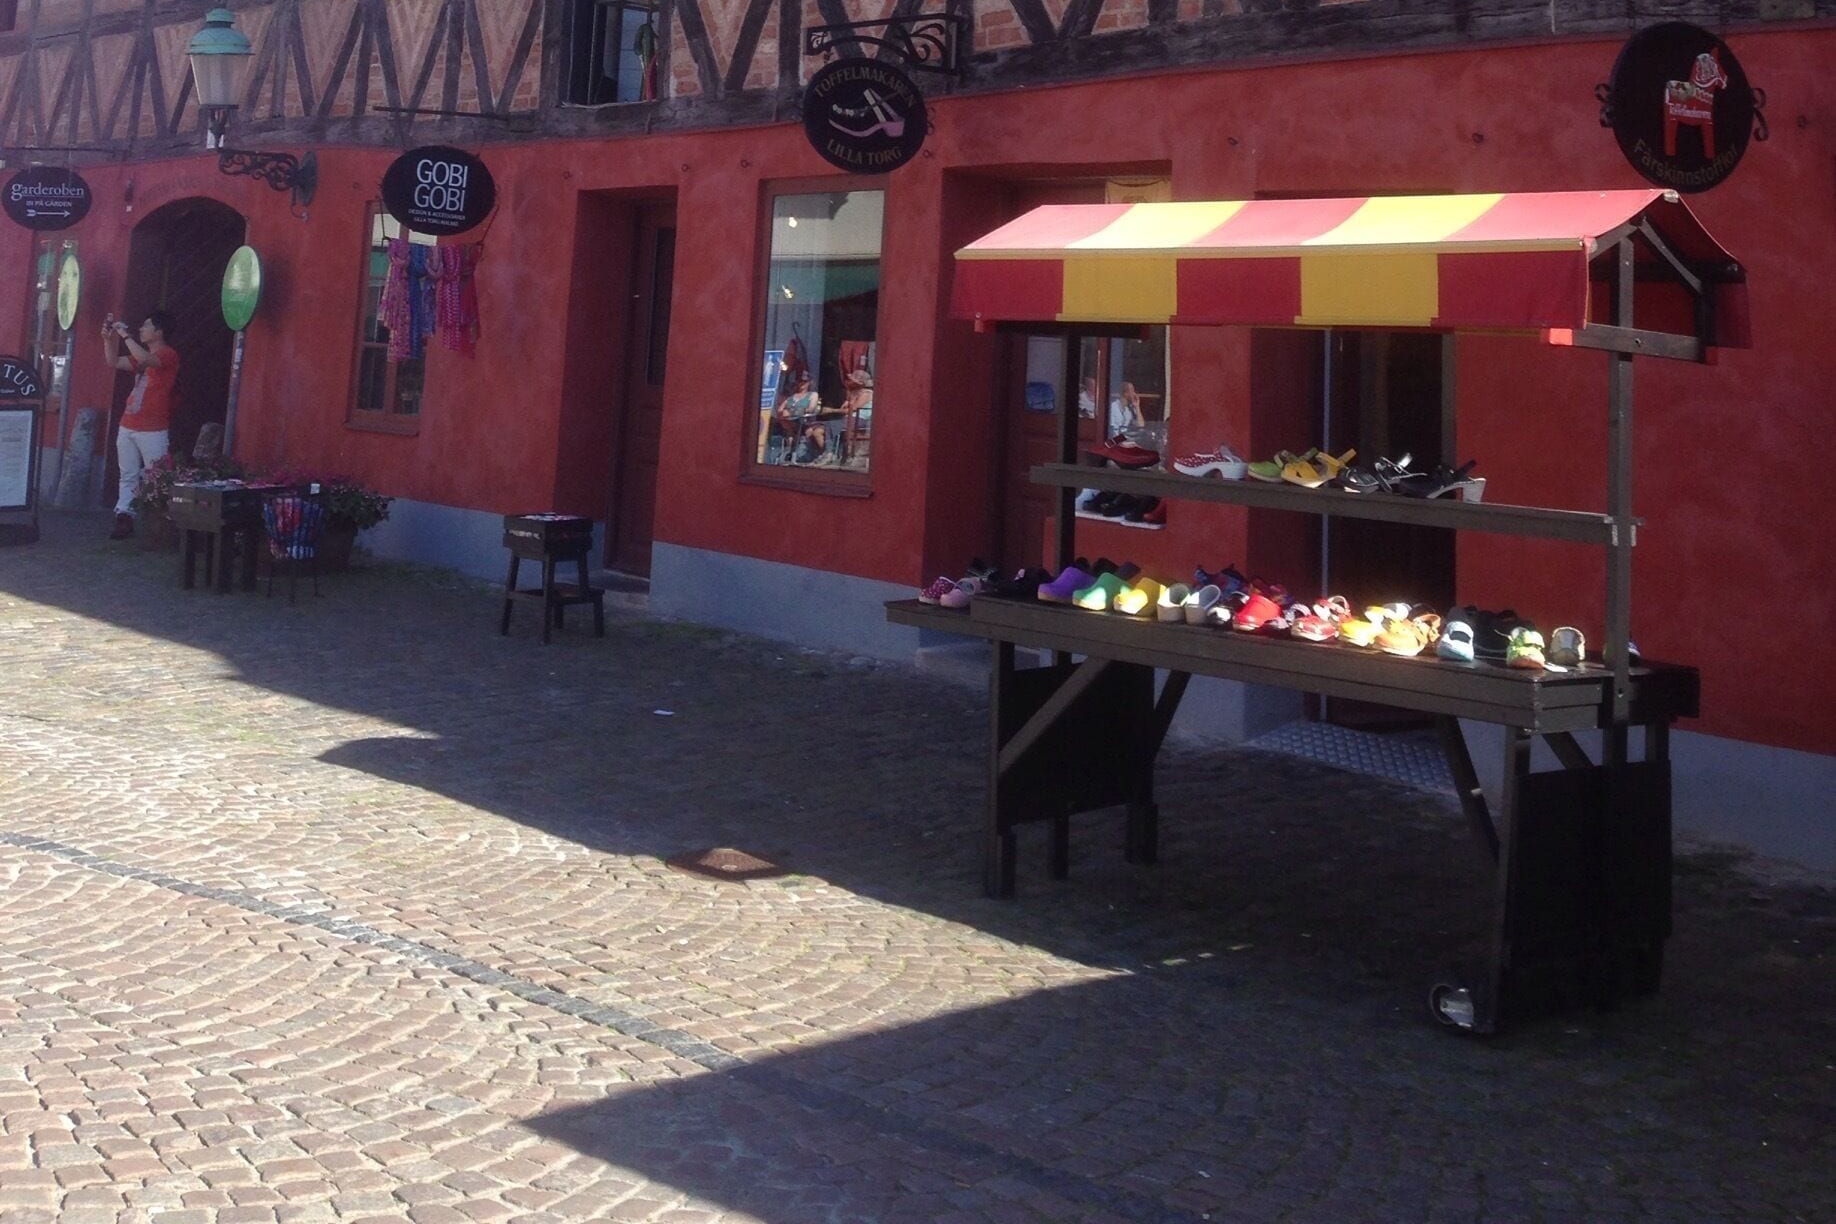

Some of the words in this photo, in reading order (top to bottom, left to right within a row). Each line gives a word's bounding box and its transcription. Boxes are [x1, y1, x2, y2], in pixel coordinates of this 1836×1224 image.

[826, 139, 863, 164] LILLA
[868, 146, 902, 164] TORG
[417, 160, 468, 188] GOBI
[11, 182, 85, 201] garderoben
[414, 184, 465, 212] GOBI
